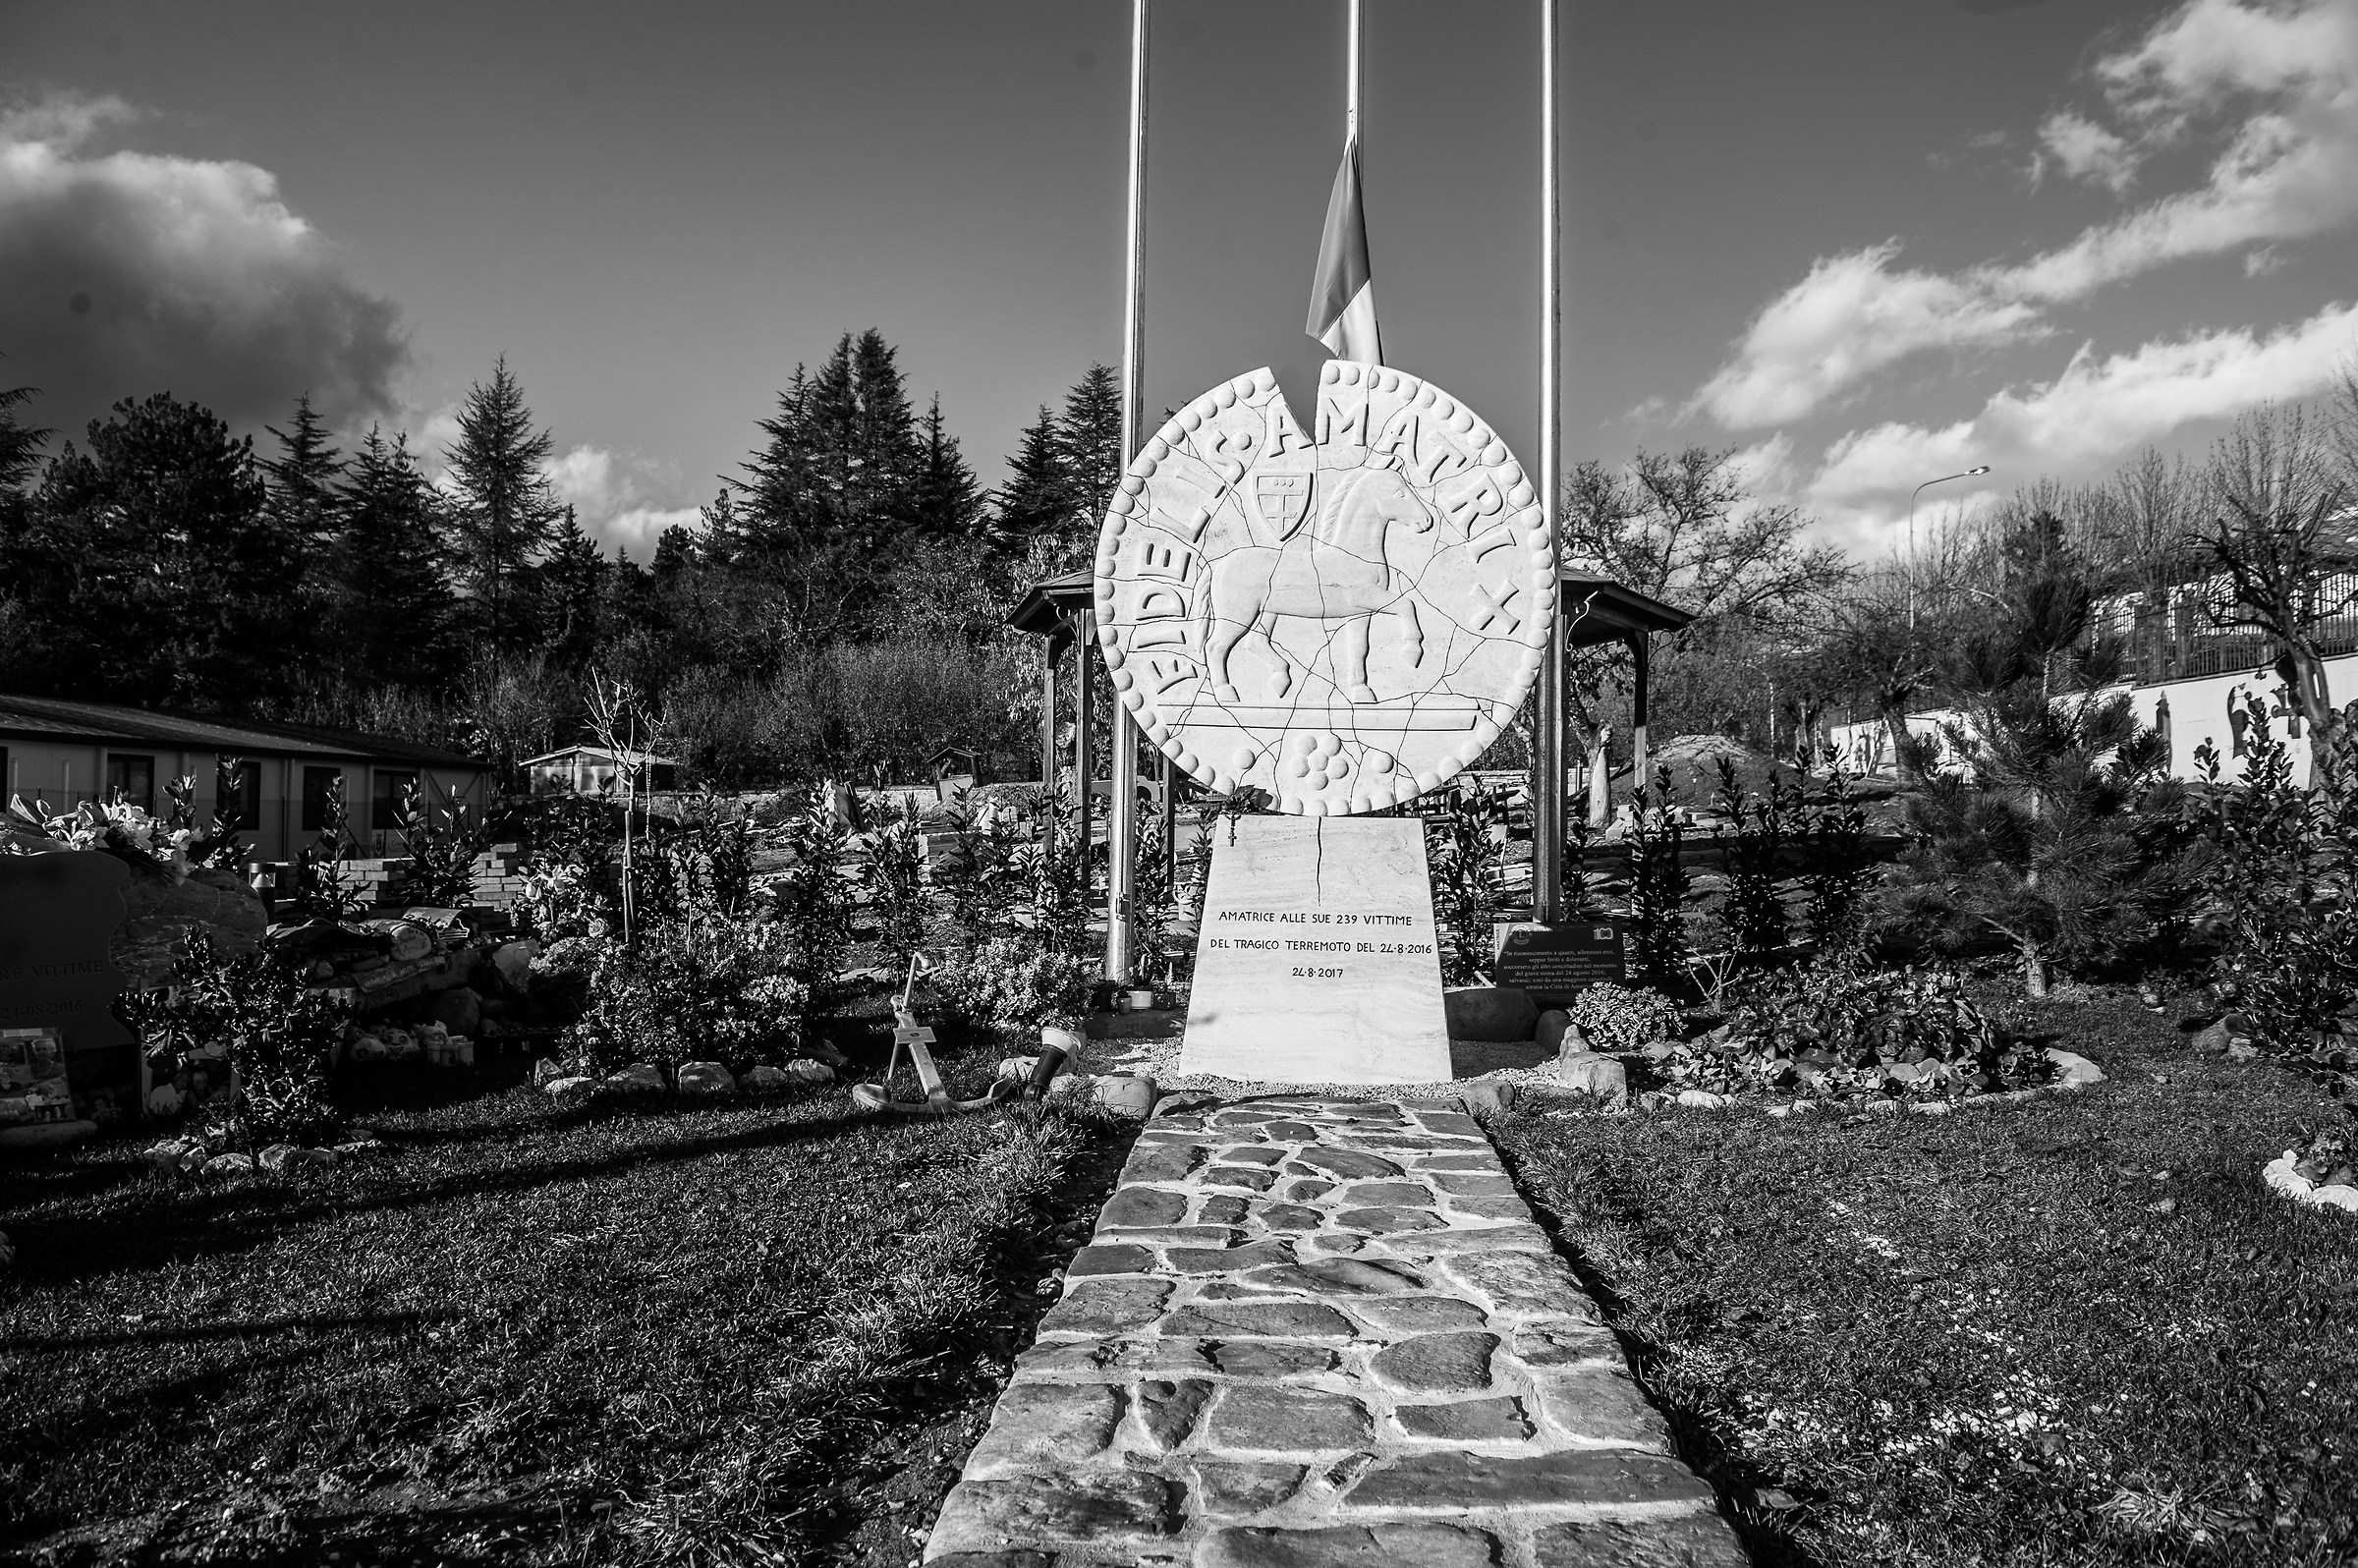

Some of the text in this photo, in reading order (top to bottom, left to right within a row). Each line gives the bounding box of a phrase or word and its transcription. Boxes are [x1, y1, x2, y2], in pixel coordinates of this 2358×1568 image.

[1135, 395, 1522, 696] FIDELIS AMATRIX
[1218, 910, 1413, 926] AMATRICE ALLE SUE 239 VITTIME
[1210, 938, 1230, 950] DEL
[1234, 939, 1279, 950] TRAGICO
[1285, 940, 1351, 953] TERREMOTO
[1357, 941, 1376, 953] DEL
[31, 960, 104, 978] VITTIME
[1, 999, 84, 1019] 24-08-2016
